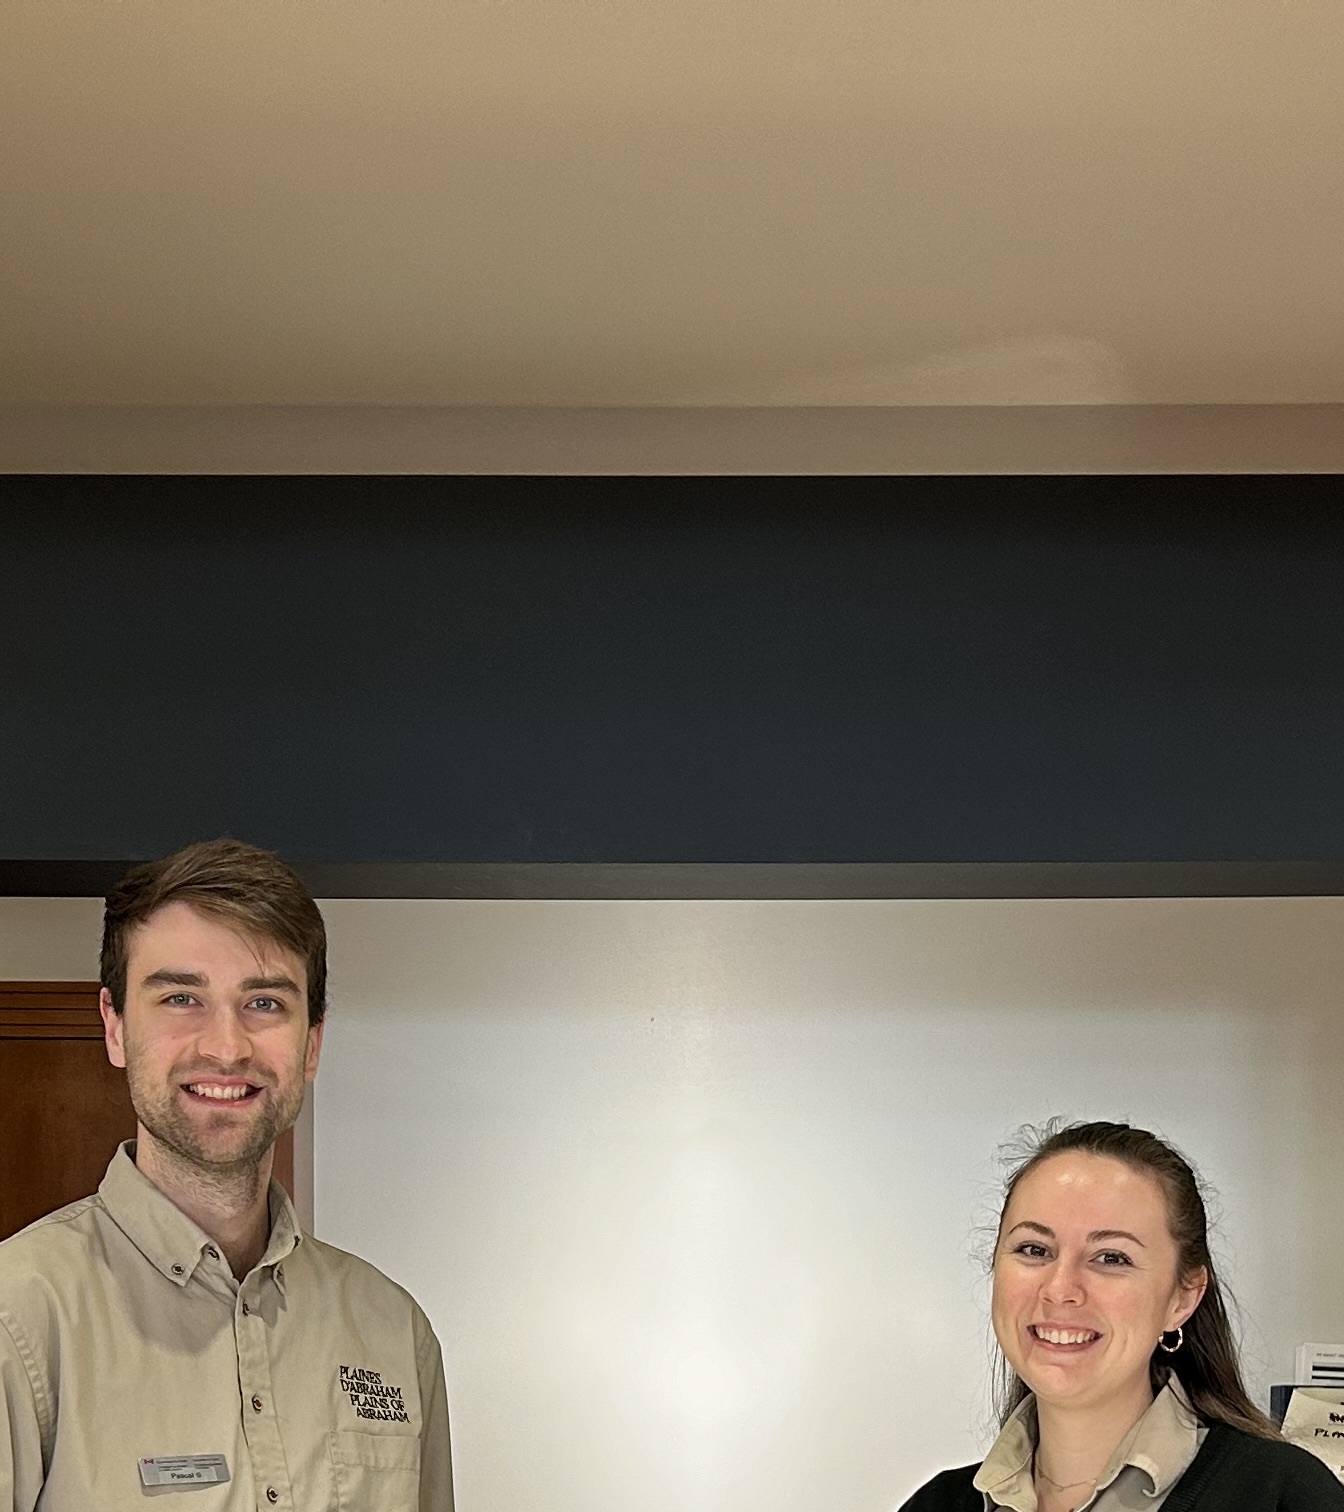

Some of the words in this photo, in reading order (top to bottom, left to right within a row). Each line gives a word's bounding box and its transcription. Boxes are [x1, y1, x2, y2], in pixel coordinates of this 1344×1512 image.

[340, 1365, 382, 1384] PLAINES
[340, 1379, 403, 1399] D'ABRAHAM
[349, 1393, 389, 1409] PLAINS
[391, 1399, 405, 1411] OF
[357, 1407, 411, 1424] ABRAHAM
